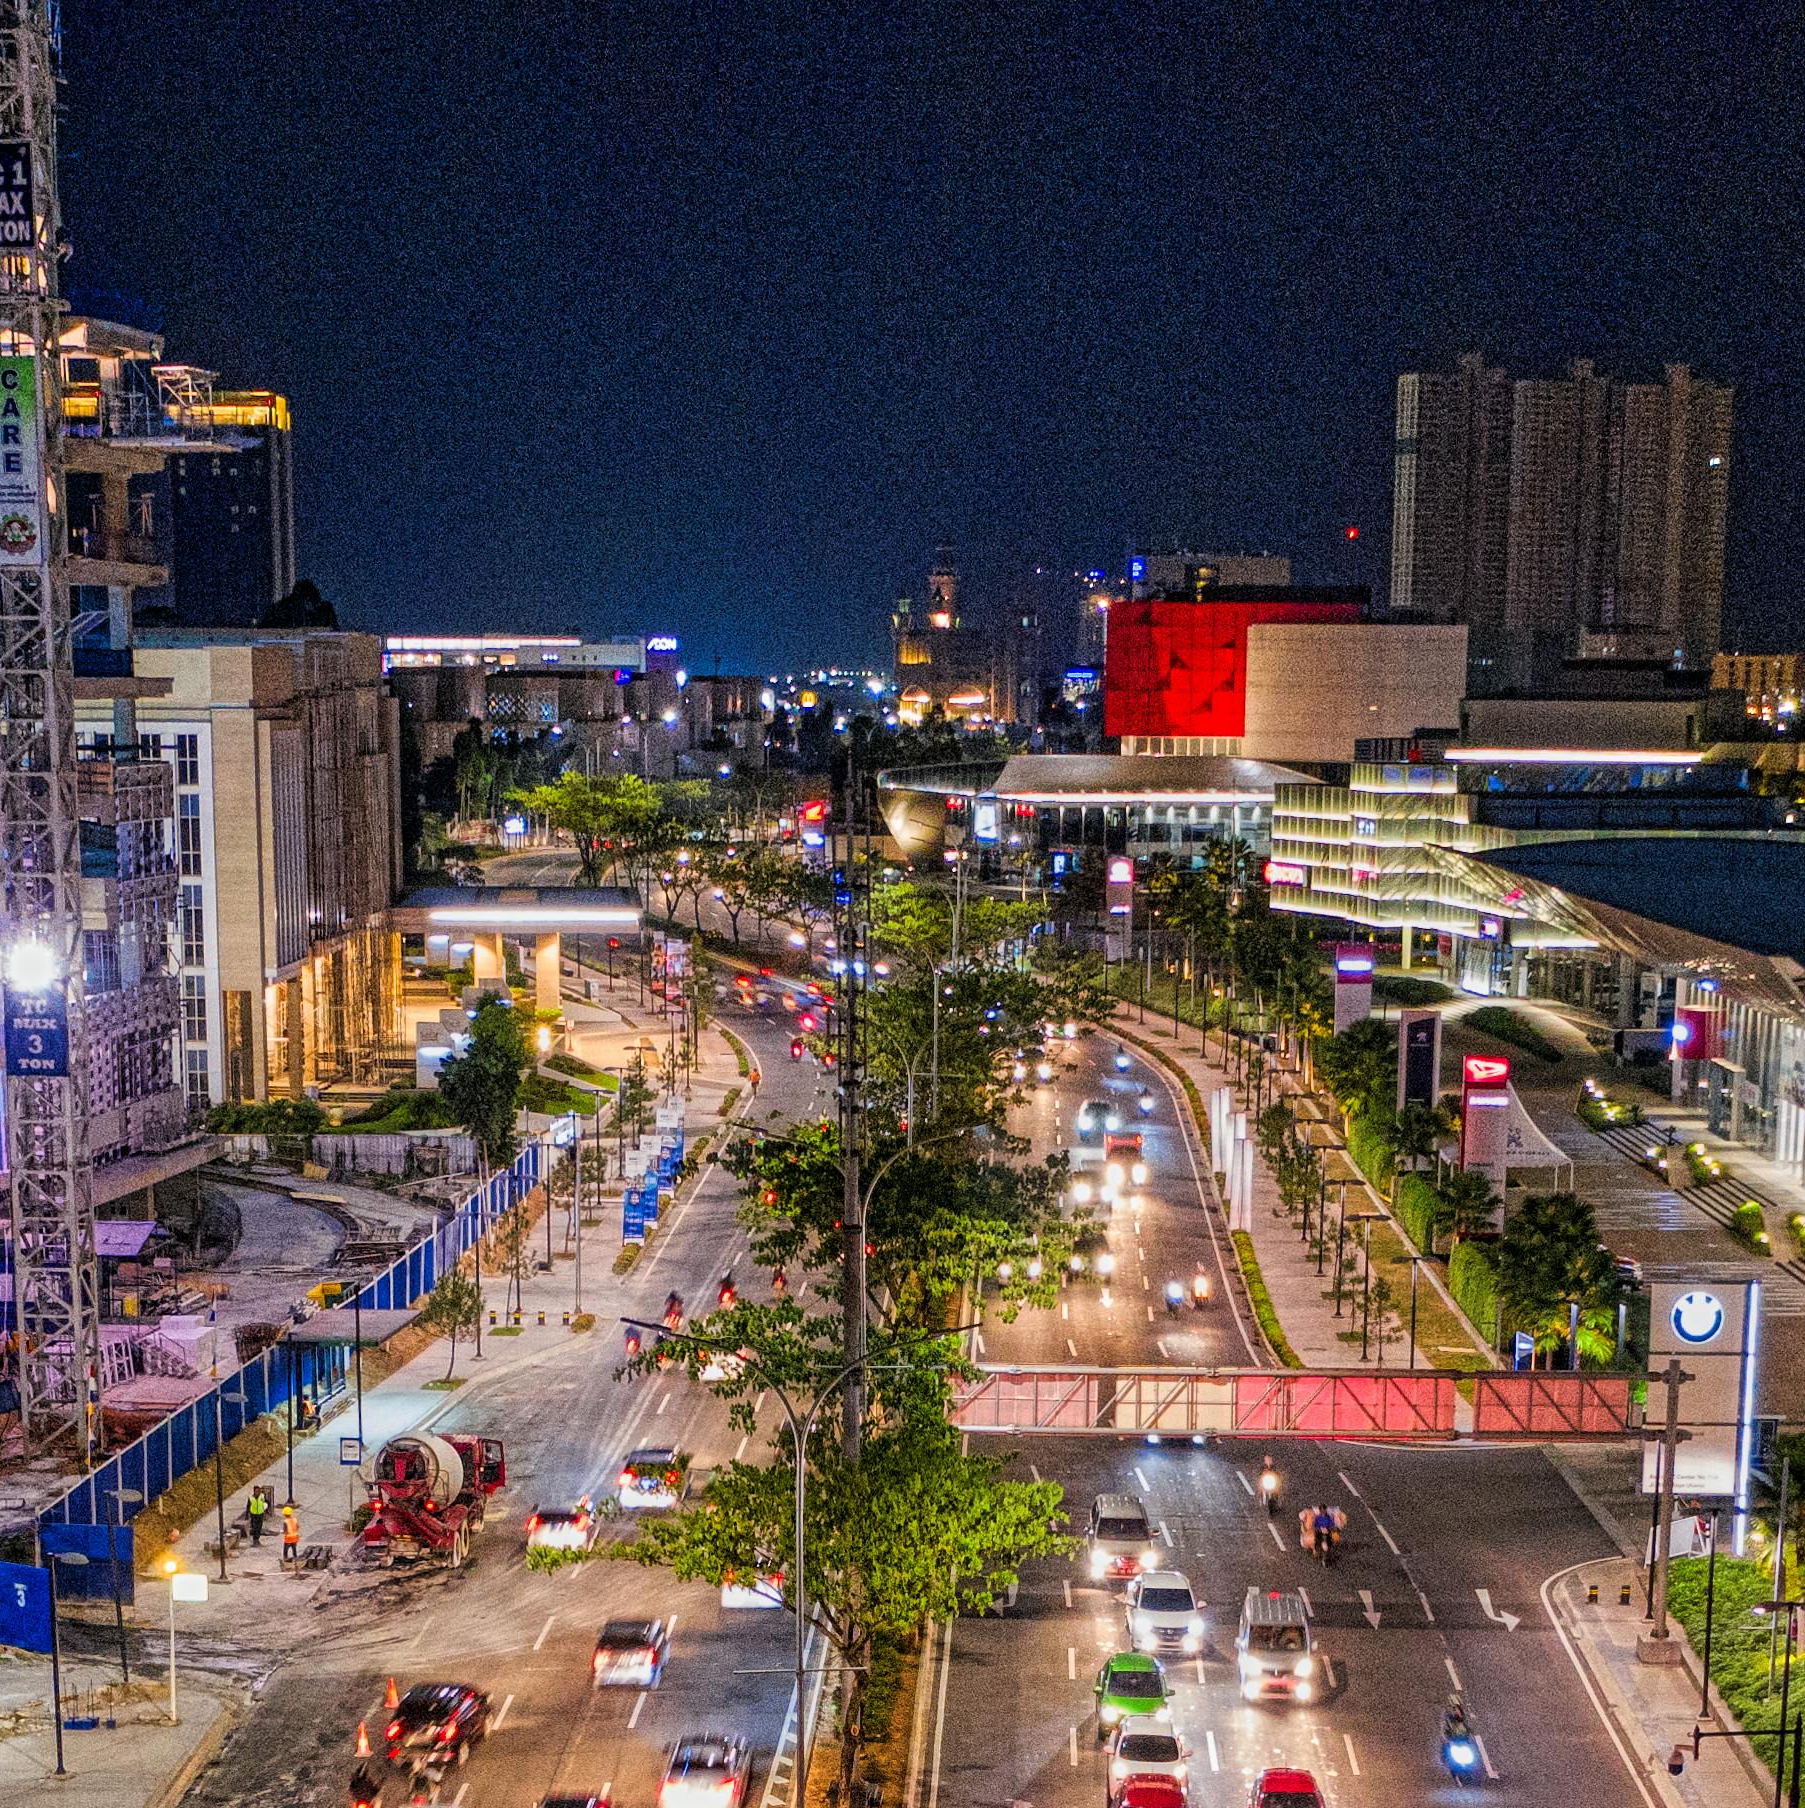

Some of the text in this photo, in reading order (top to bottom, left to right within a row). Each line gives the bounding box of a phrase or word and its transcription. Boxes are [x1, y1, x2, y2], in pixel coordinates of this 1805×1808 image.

[12, 160, 28, 186] 1
[0, 368, 22, 474] CARE
[12, 1018, 58, 1030] MAX
[27, 1034, 44, 1054] 3
[17, 1058, 56, 1070] TON
[16, 1590, 26, 1608] 3
